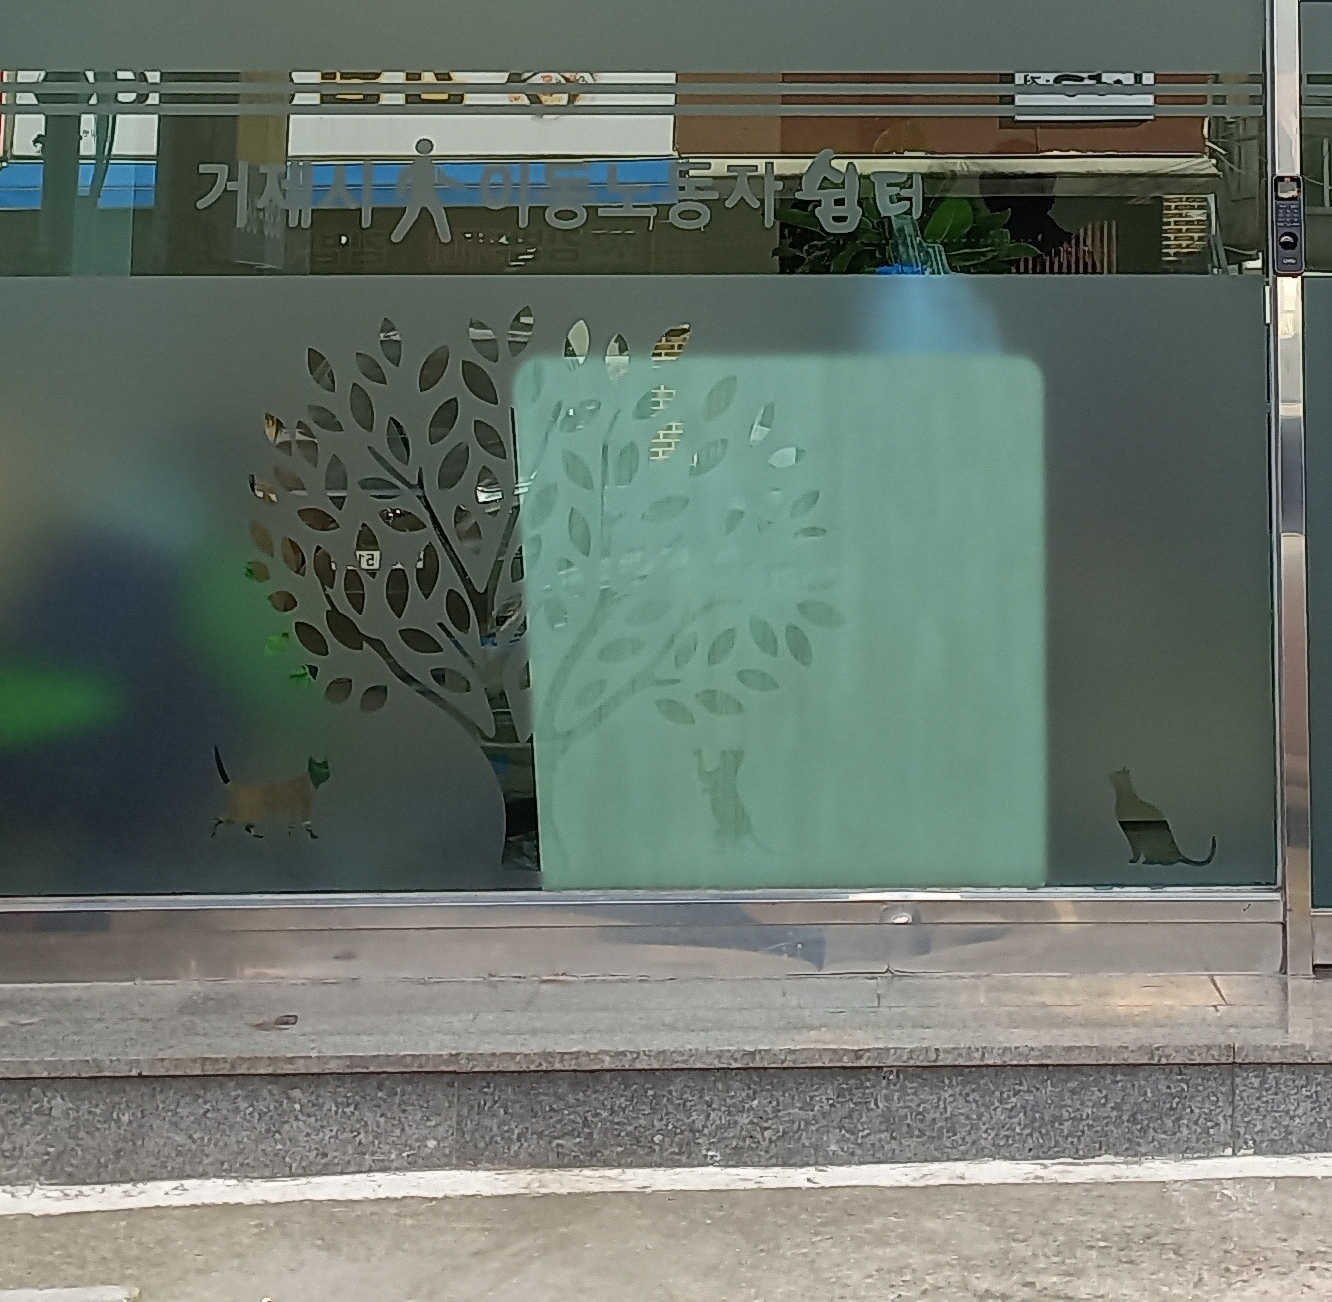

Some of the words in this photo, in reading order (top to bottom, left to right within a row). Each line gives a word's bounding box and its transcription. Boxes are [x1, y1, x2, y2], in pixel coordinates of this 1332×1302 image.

[196, 160, 373, 231] 거제시
[480, 160, 785, 232] 이동노동자
[801, 148, 926, 236] 쉼터
